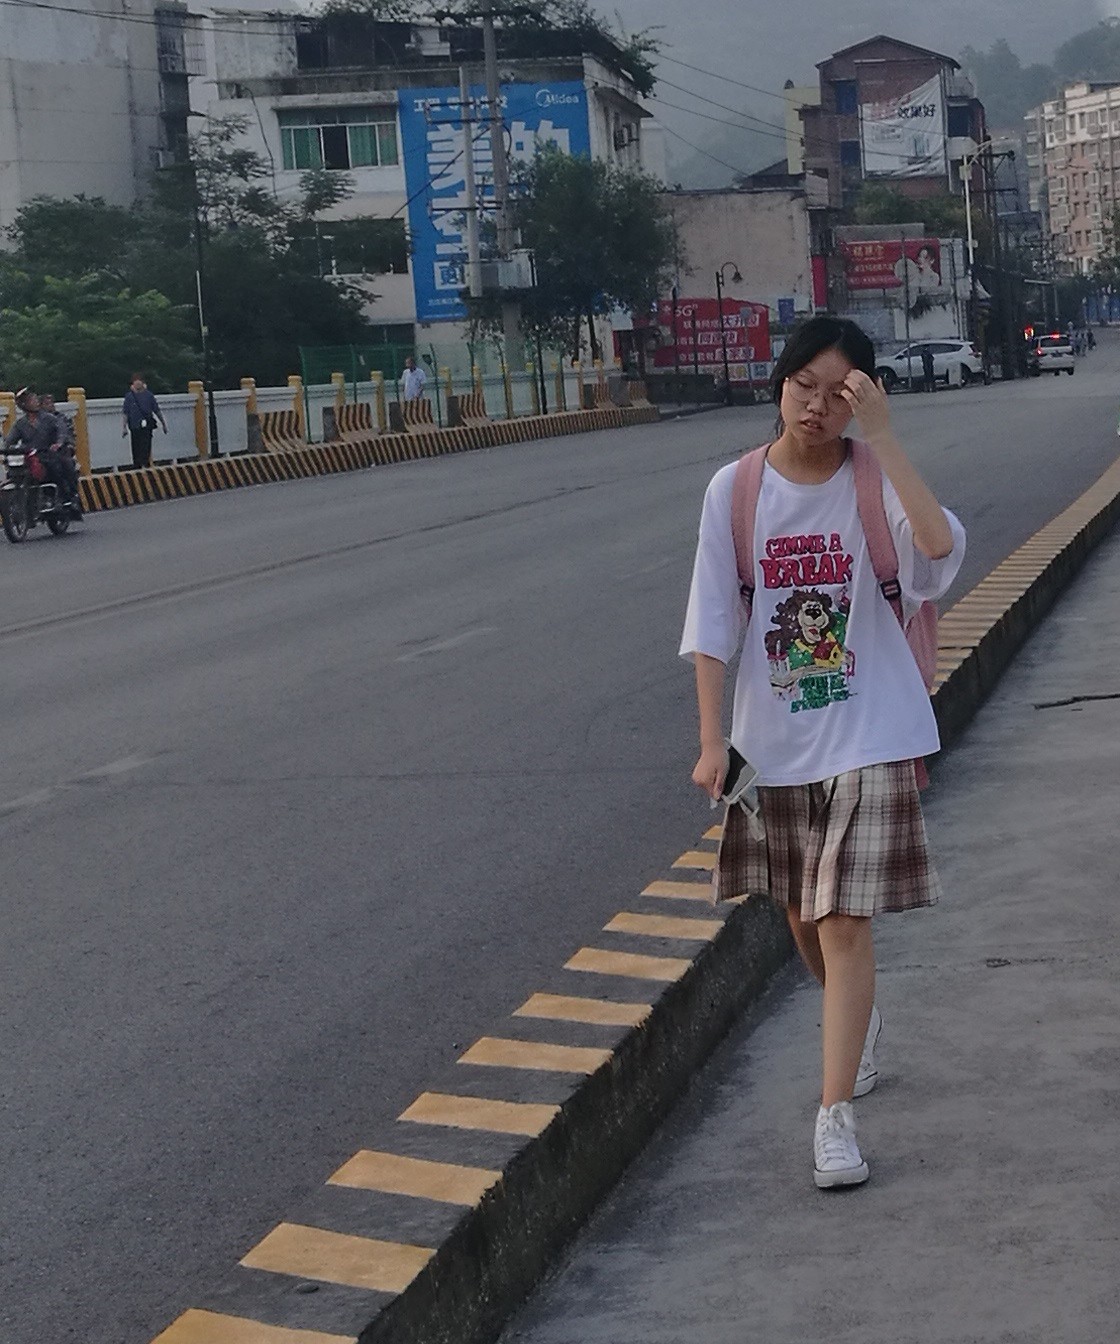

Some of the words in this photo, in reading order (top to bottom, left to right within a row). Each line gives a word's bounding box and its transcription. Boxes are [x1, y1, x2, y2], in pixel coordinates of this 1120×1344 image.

[765, 534, 827, 559] GIMME
[829, 532, 844, 552] A
[759, 553, 854, 590] BREAK
